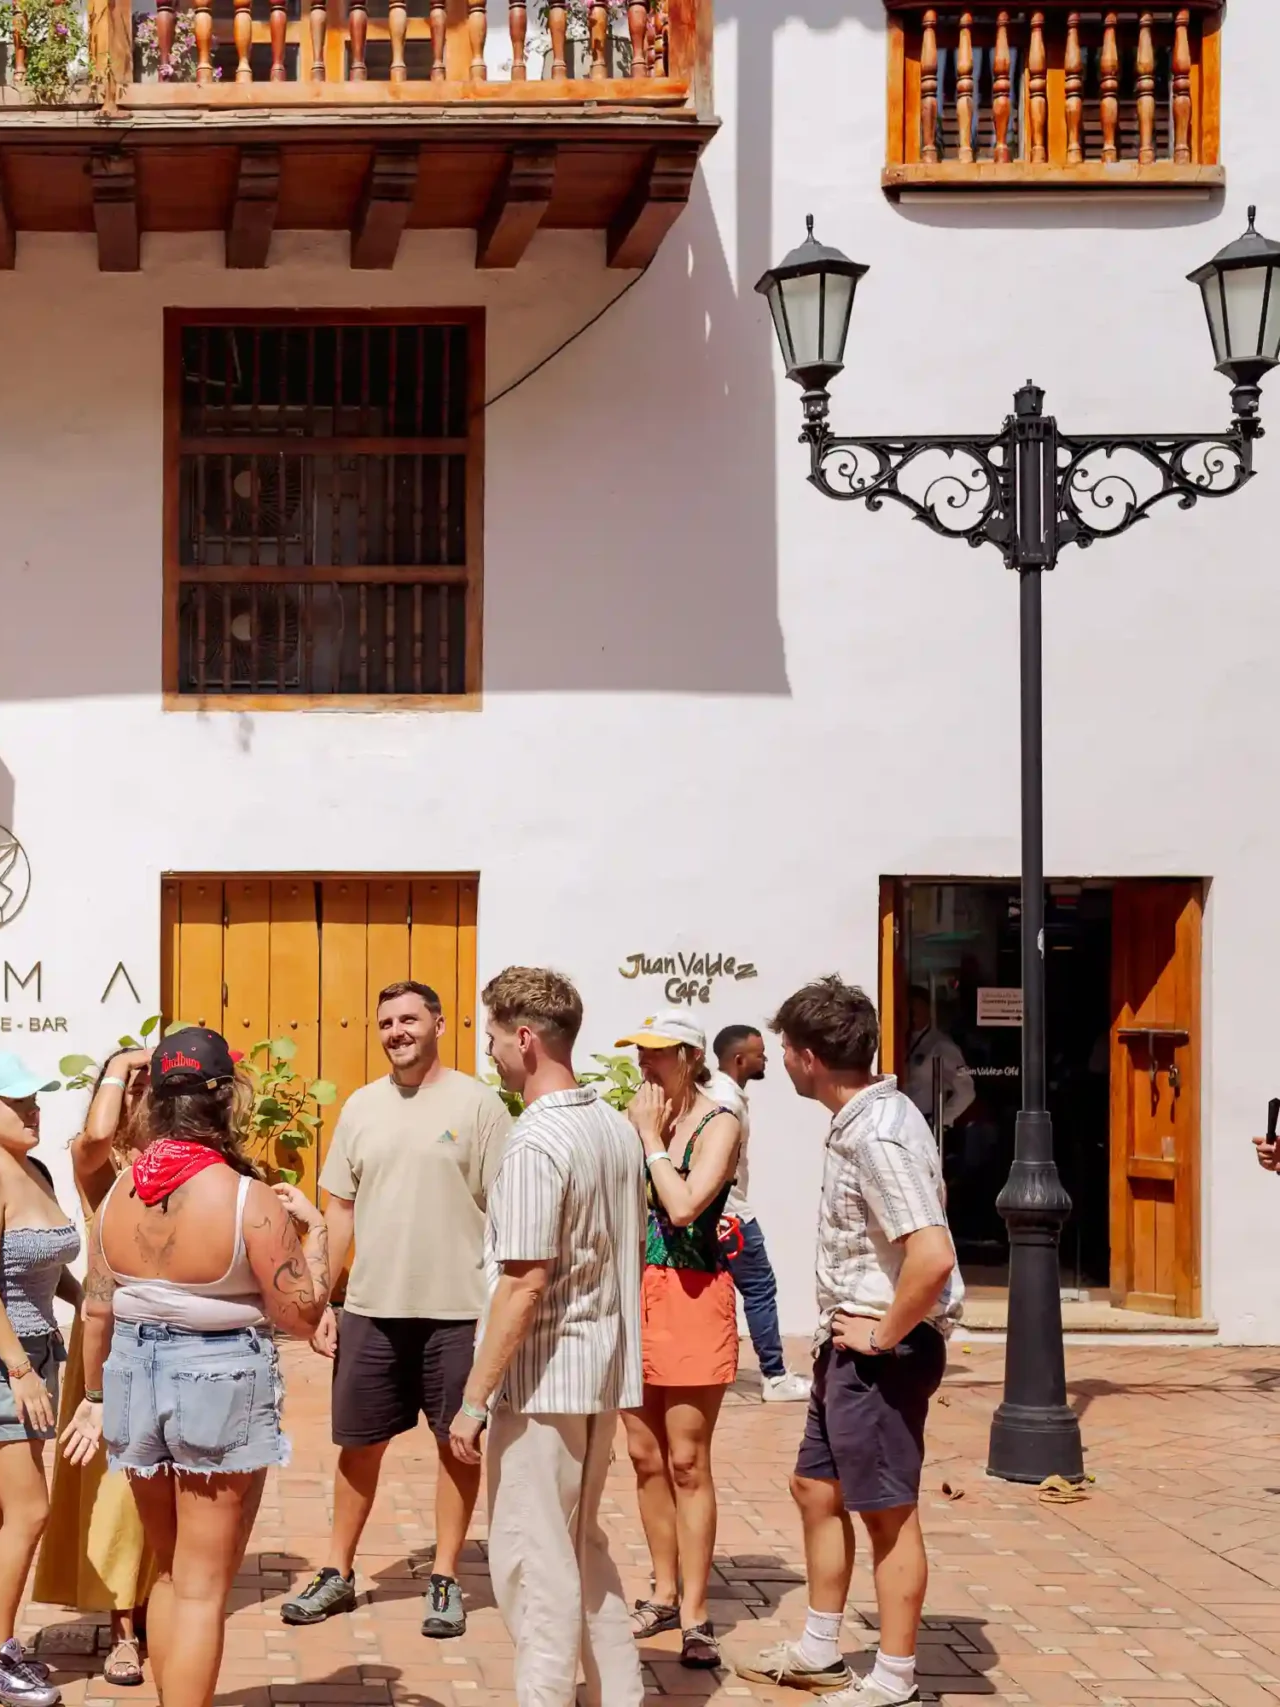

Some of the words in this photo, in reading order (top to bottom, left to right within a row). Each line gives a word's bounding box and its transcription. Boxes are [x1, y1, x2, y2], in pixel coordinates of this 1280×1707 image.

[618, 952, 676, 979] Juan
[677, 952, 758, 981] Valdez
[665, 977, 713, 1006] Café
[29, 1017, 68, 1032] BAR
